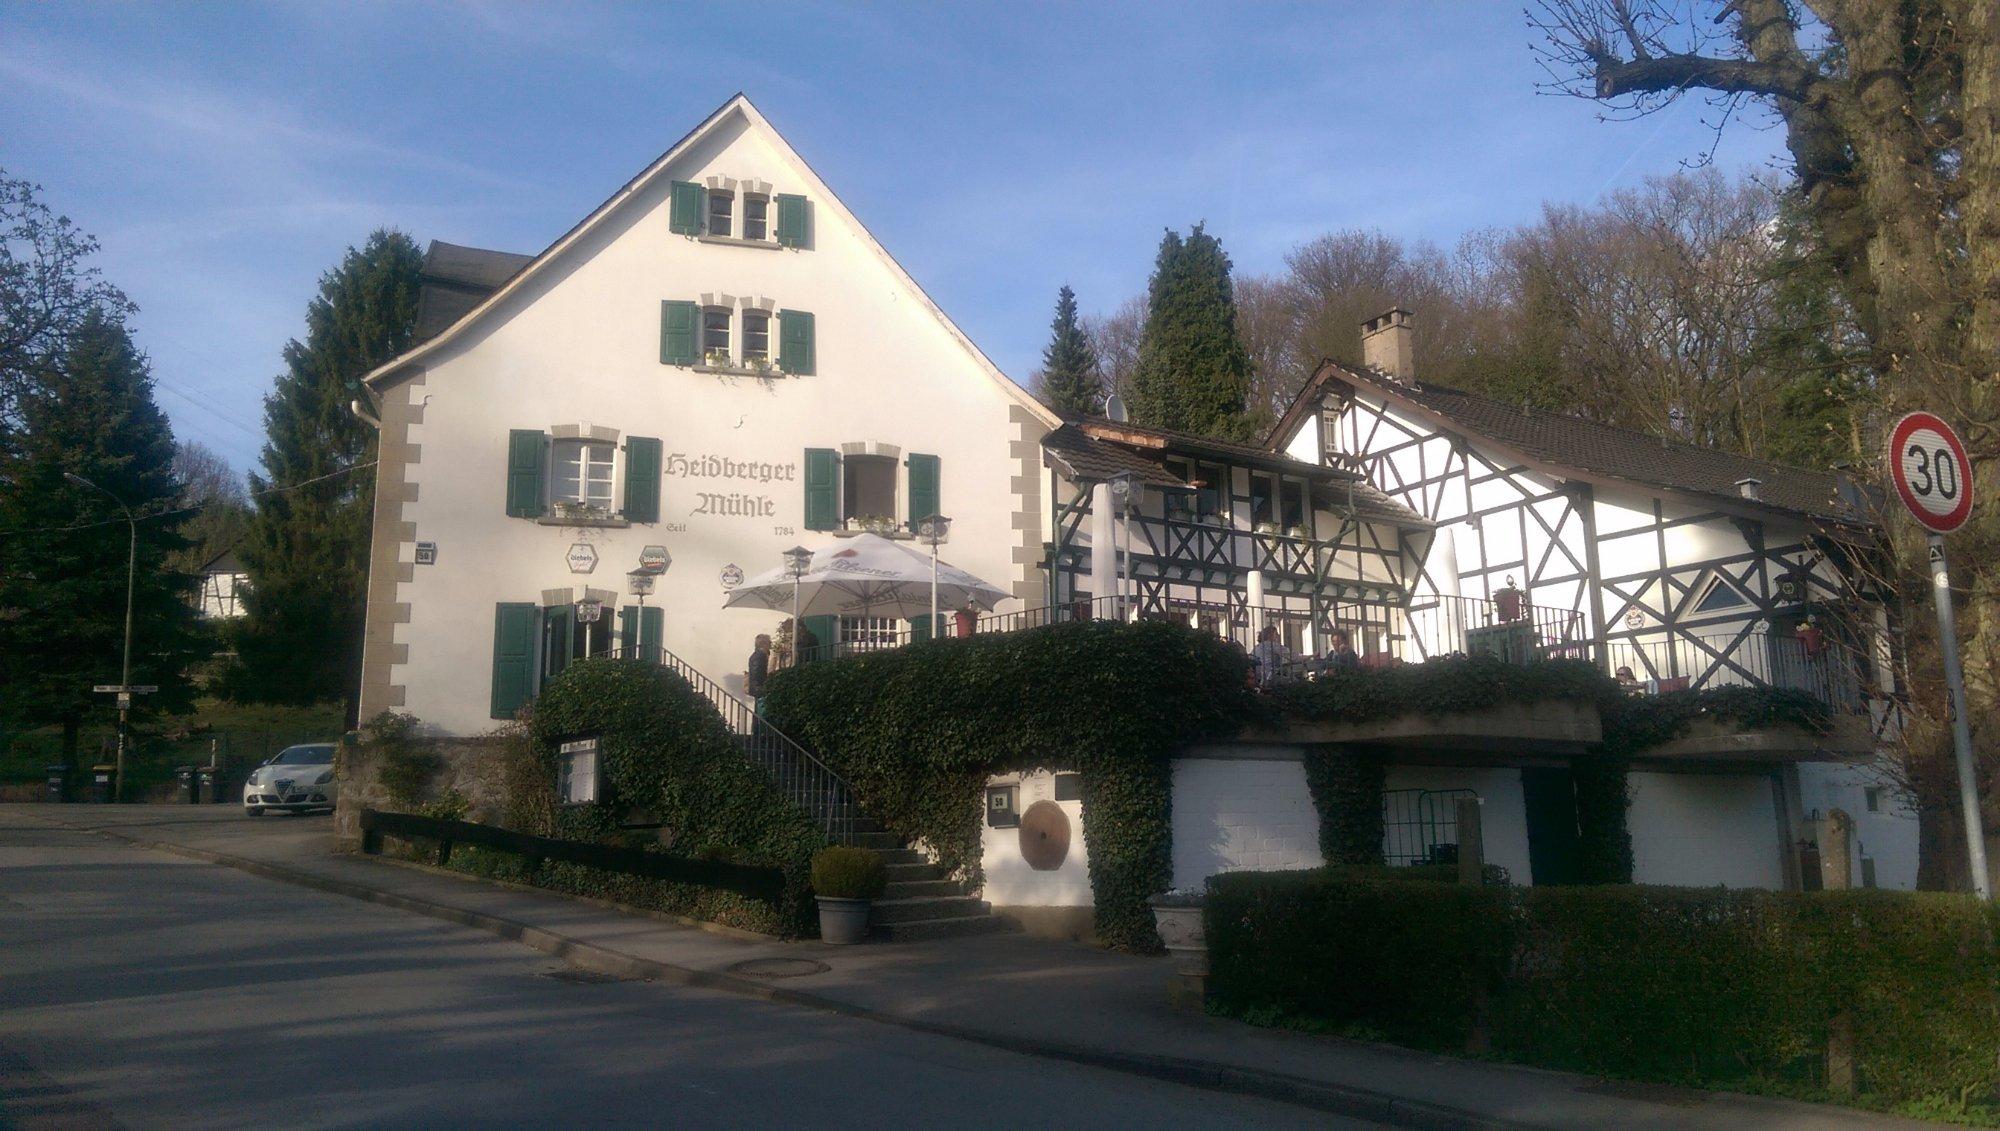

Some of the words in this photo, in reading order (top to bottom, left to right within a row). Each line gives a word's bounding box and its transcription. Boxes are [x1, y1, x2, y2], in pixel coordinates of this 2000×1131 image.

[664, 453, 795, 483] Heidberger
[1908, 444, 1957, 500] 30
[689, 492, 776, 518] Mühle
[774, 526, 795, 537] 1784
